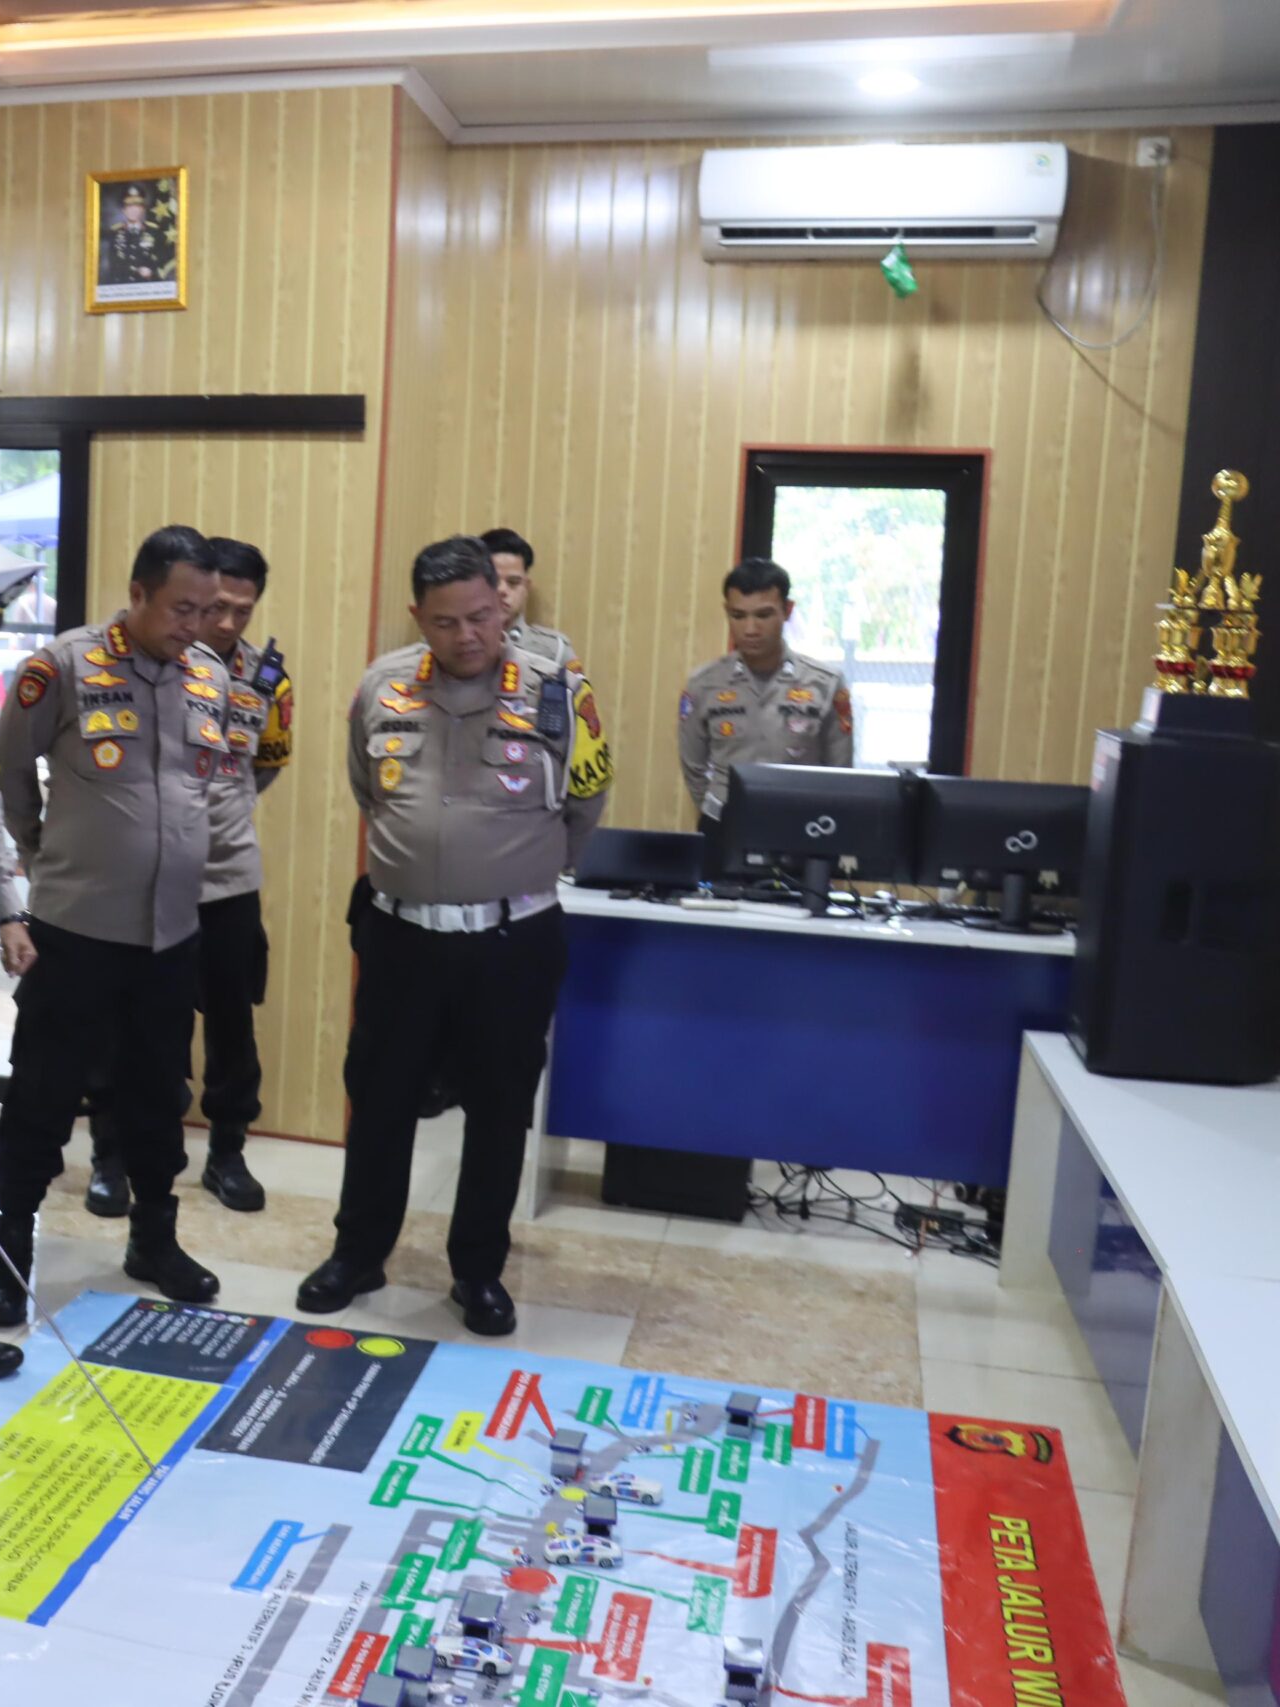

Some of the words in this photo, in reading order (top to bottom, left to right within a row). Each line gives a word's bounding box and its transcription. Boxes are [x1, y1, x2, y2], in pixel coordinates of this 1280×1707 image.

[82, 691, 133, 707] INSAN
[988, 1513, 1039, 1571] PETA
[996, 1575, 1055, 1664] JALUR
